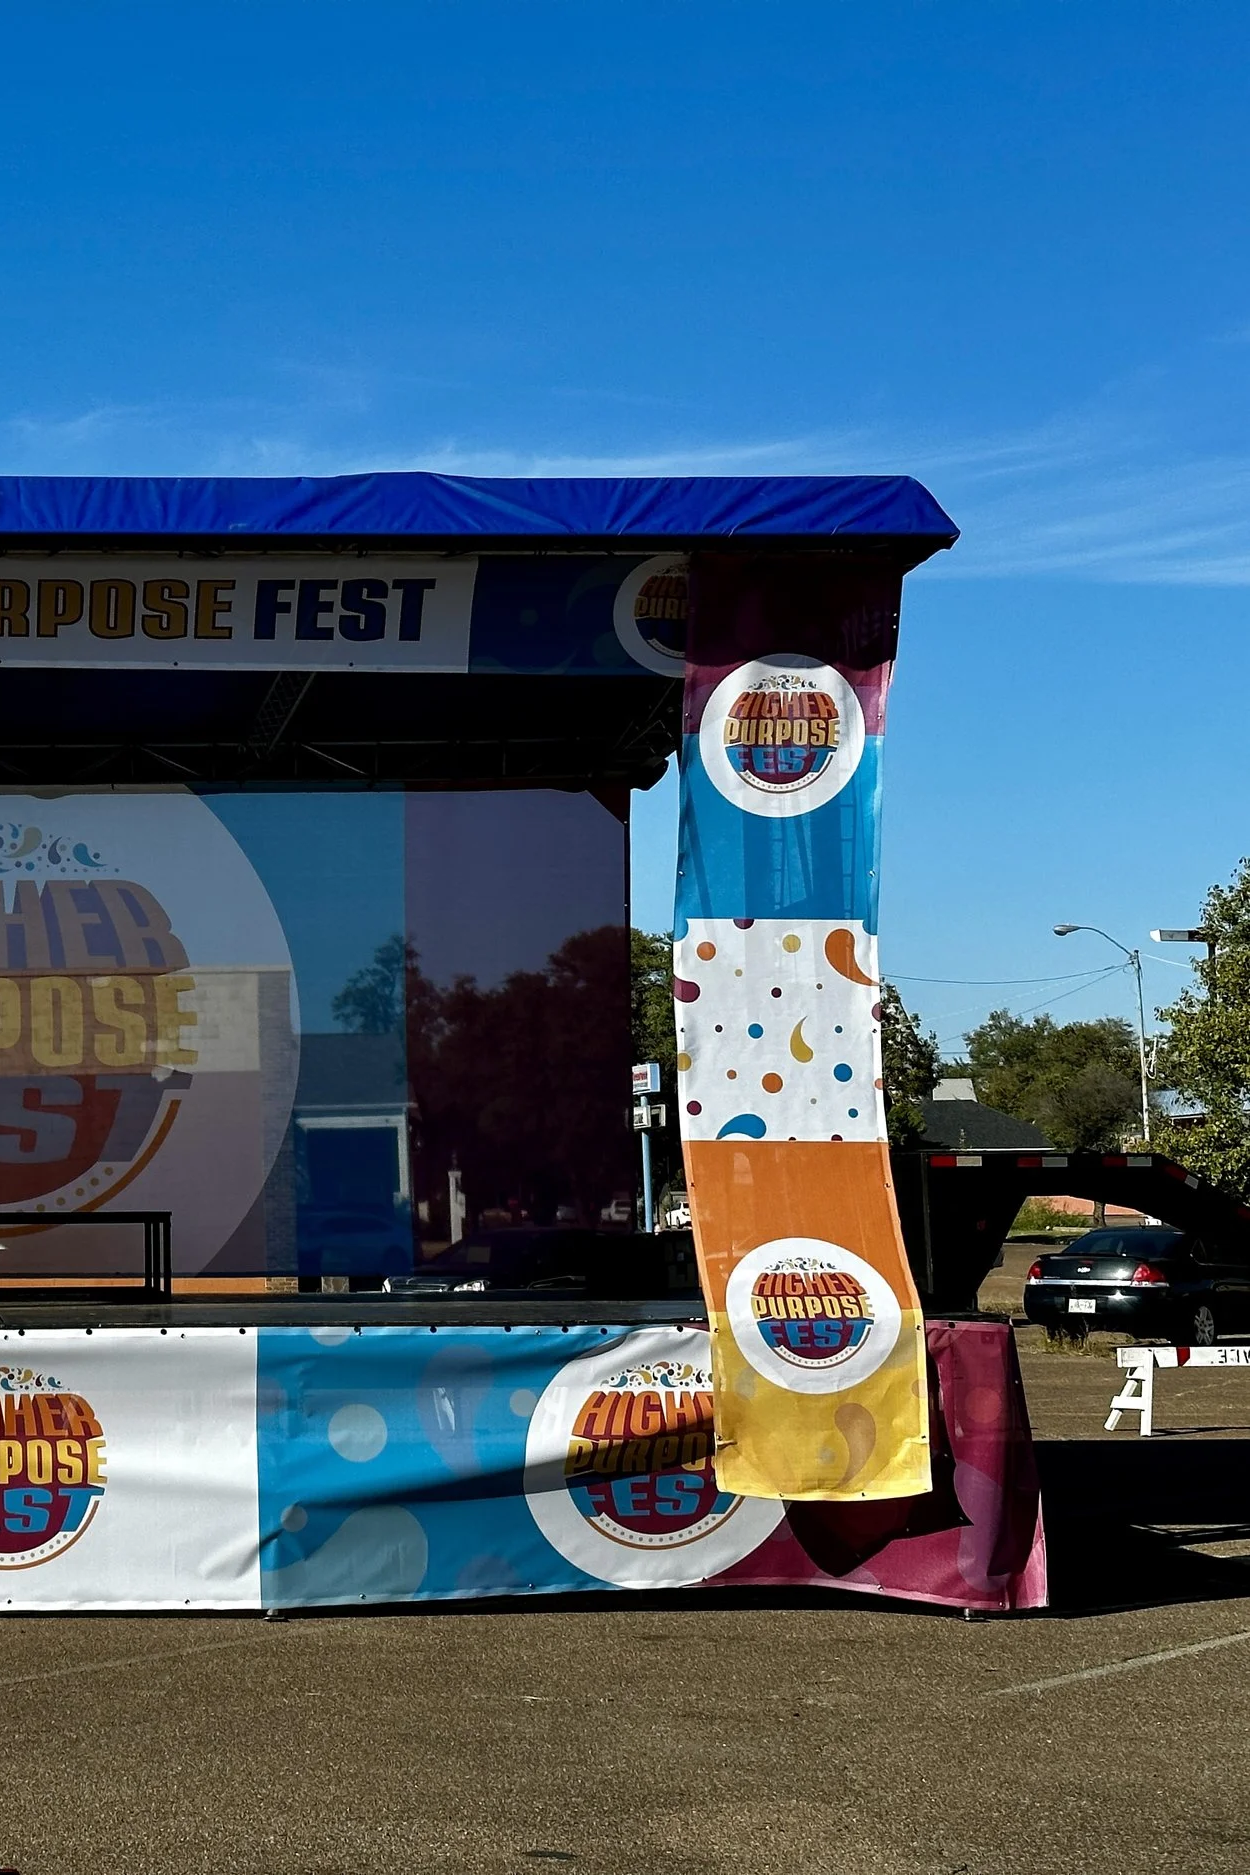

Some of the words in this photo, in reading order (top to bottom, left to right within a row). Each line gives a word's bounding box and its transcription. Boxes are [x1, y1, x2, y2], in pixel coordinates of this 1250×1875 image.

[252, 578, 436, 641] FEST
[728, 691, 839, 718] HIGHER
[724, 718, 840, 745] PURPOSE
[725, 745, 837, 773] FEST
[751, 1272, 867, 1296] HIGHER
[750, 1294, 875, 1320] PURPOSE
[756, 1318, 874, 1348] FEST
[564, 1432, 716, 1476] PURPO
